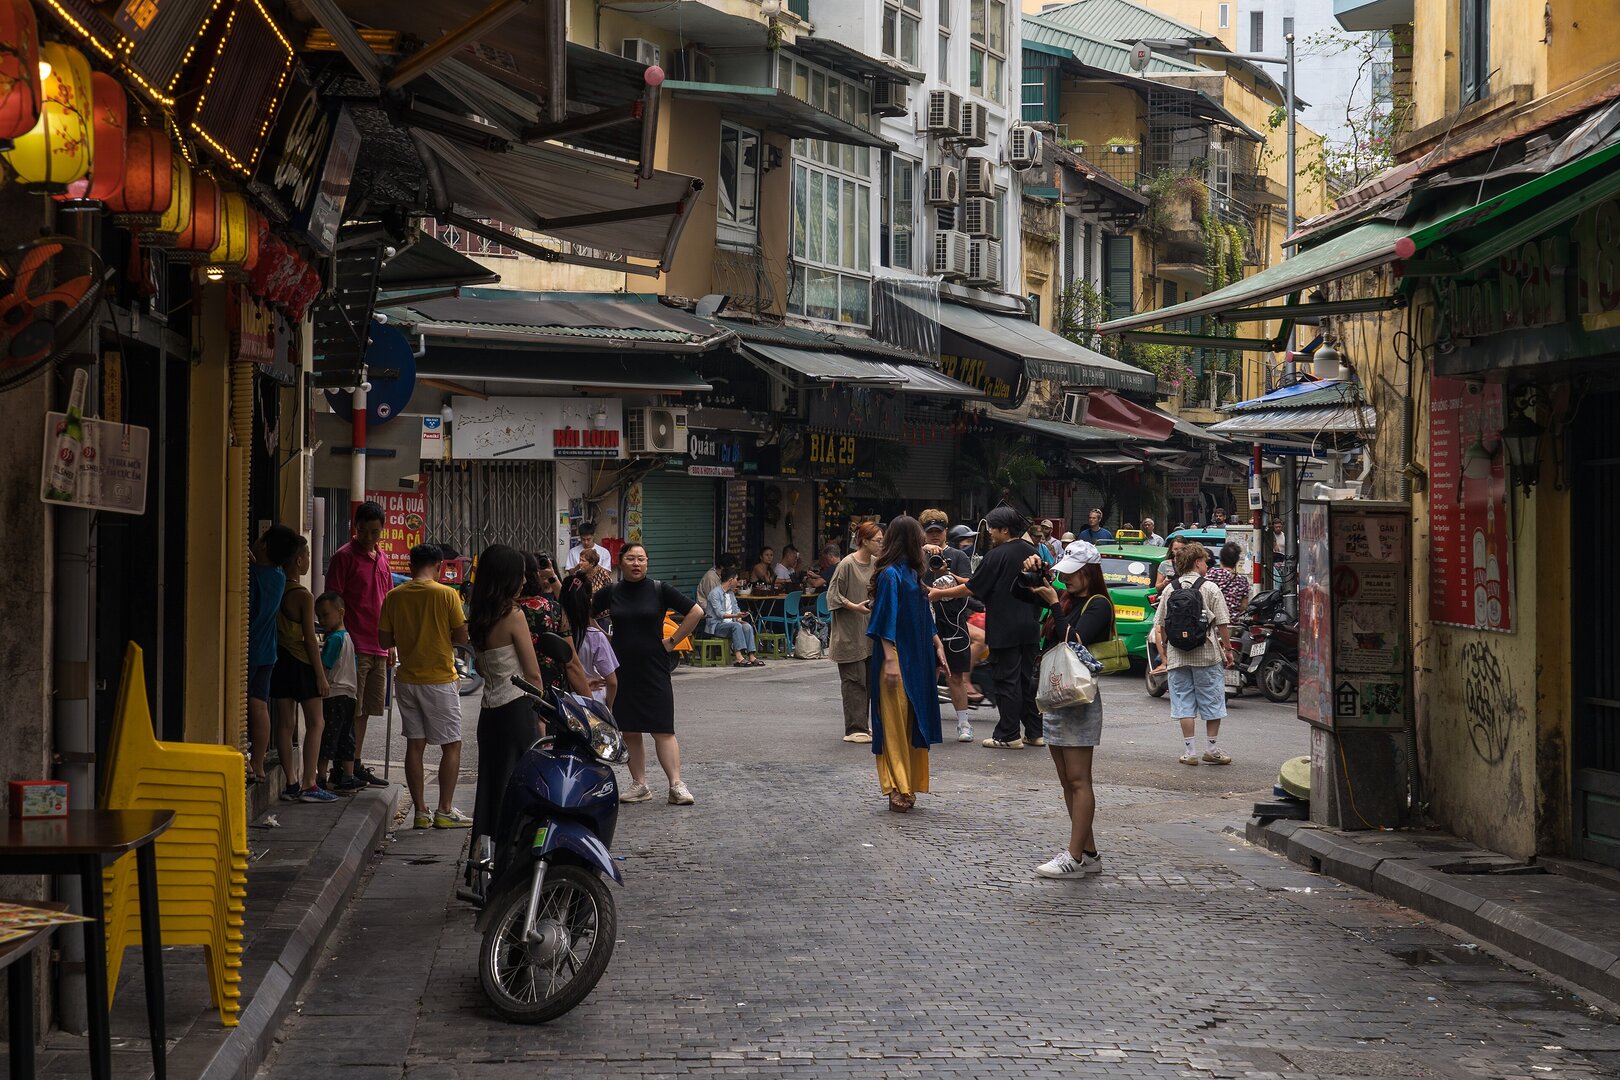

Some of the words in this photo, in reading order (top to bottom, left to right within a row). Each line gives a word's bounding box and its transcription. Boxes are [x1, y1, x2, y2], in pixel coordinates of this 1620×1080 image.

[690, 434, 716, 460] Quán
[810, 433, 836, 463] BIA
[838, 436, 855, 465] 29
[390, 494, 403, 511] CÁ
[406, 493, 424, 513] QUẢ
[560, 754, 583, 763] HONDA
